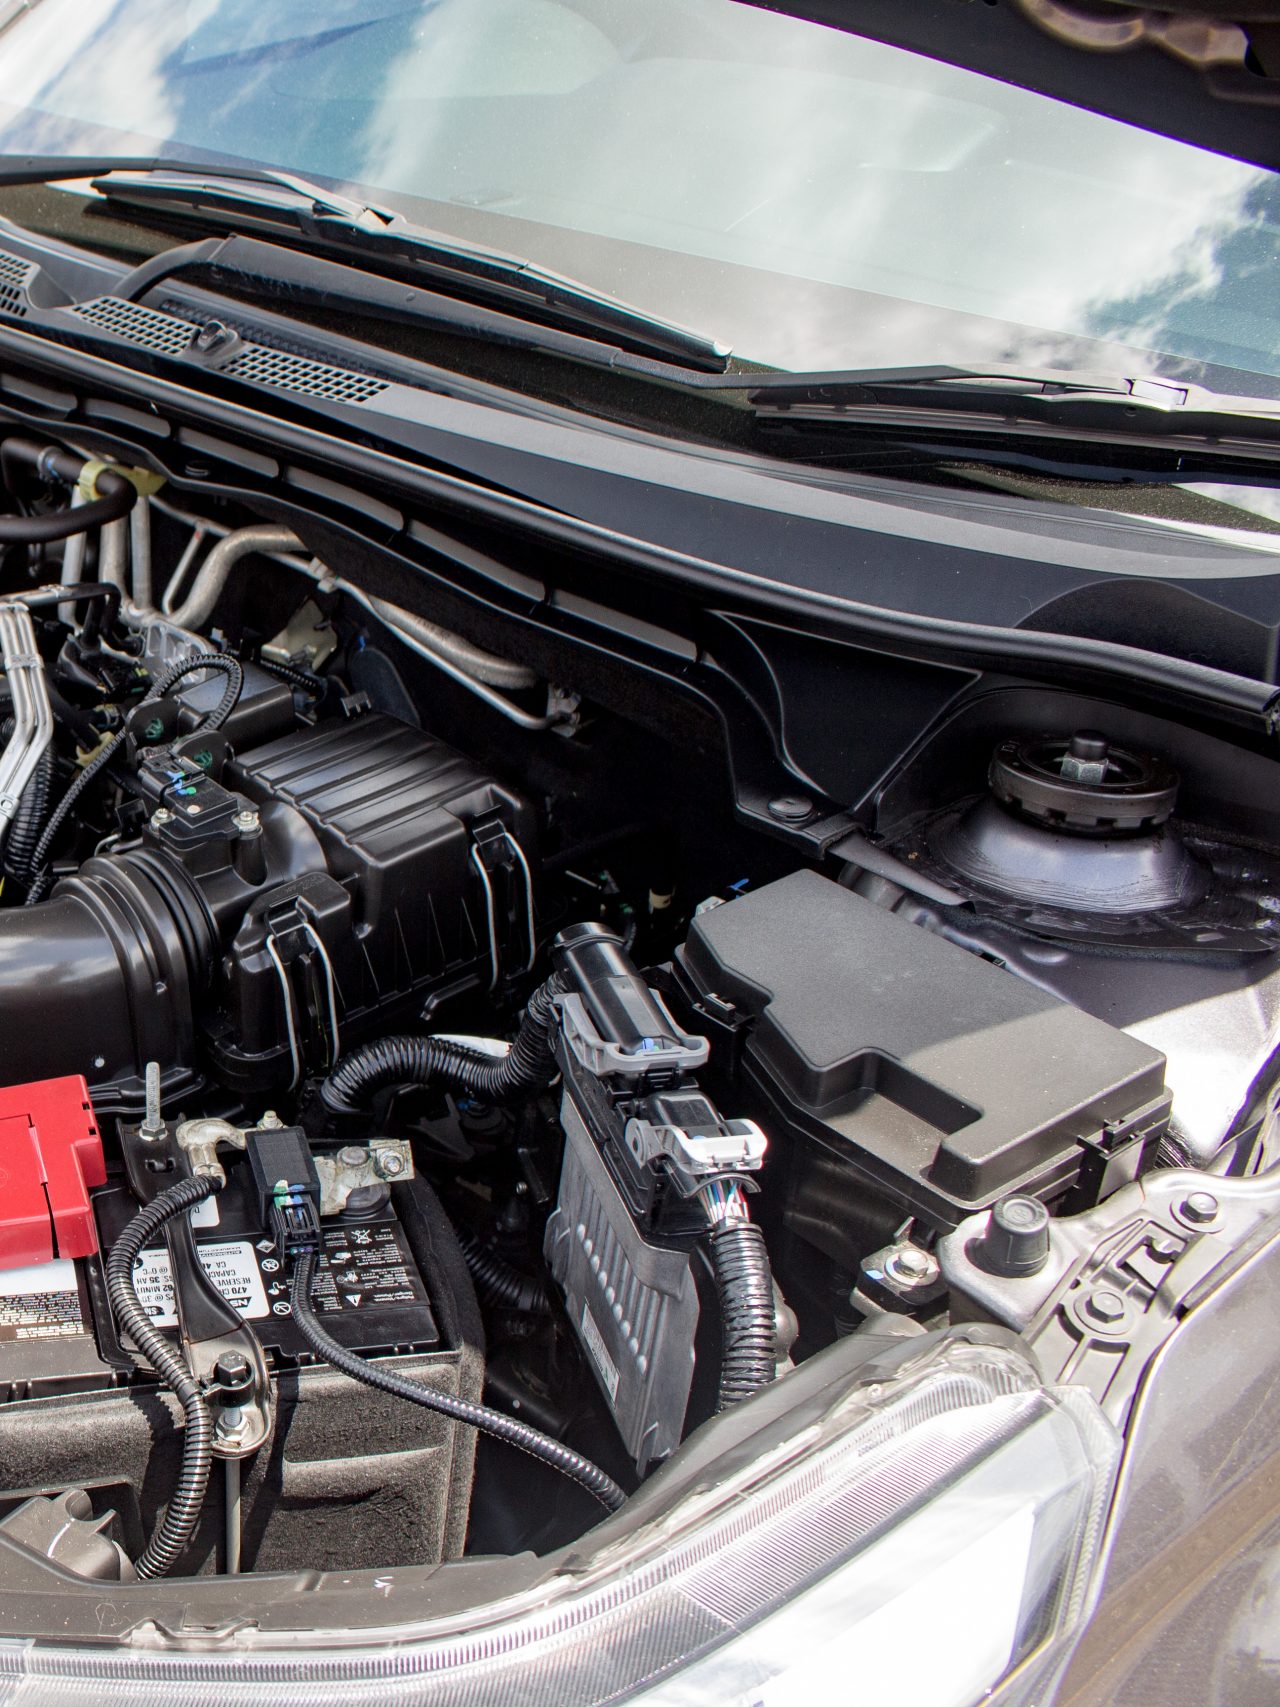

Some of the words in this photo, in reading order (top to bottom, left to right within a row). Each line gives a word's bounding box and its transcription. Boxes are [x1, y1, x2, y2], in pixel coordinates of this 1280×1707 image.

[149, 1277, 160, 1285] 35
[216, 1277, 251, 1286] RESERVE
[231, 1287, 247, 1295] 470
